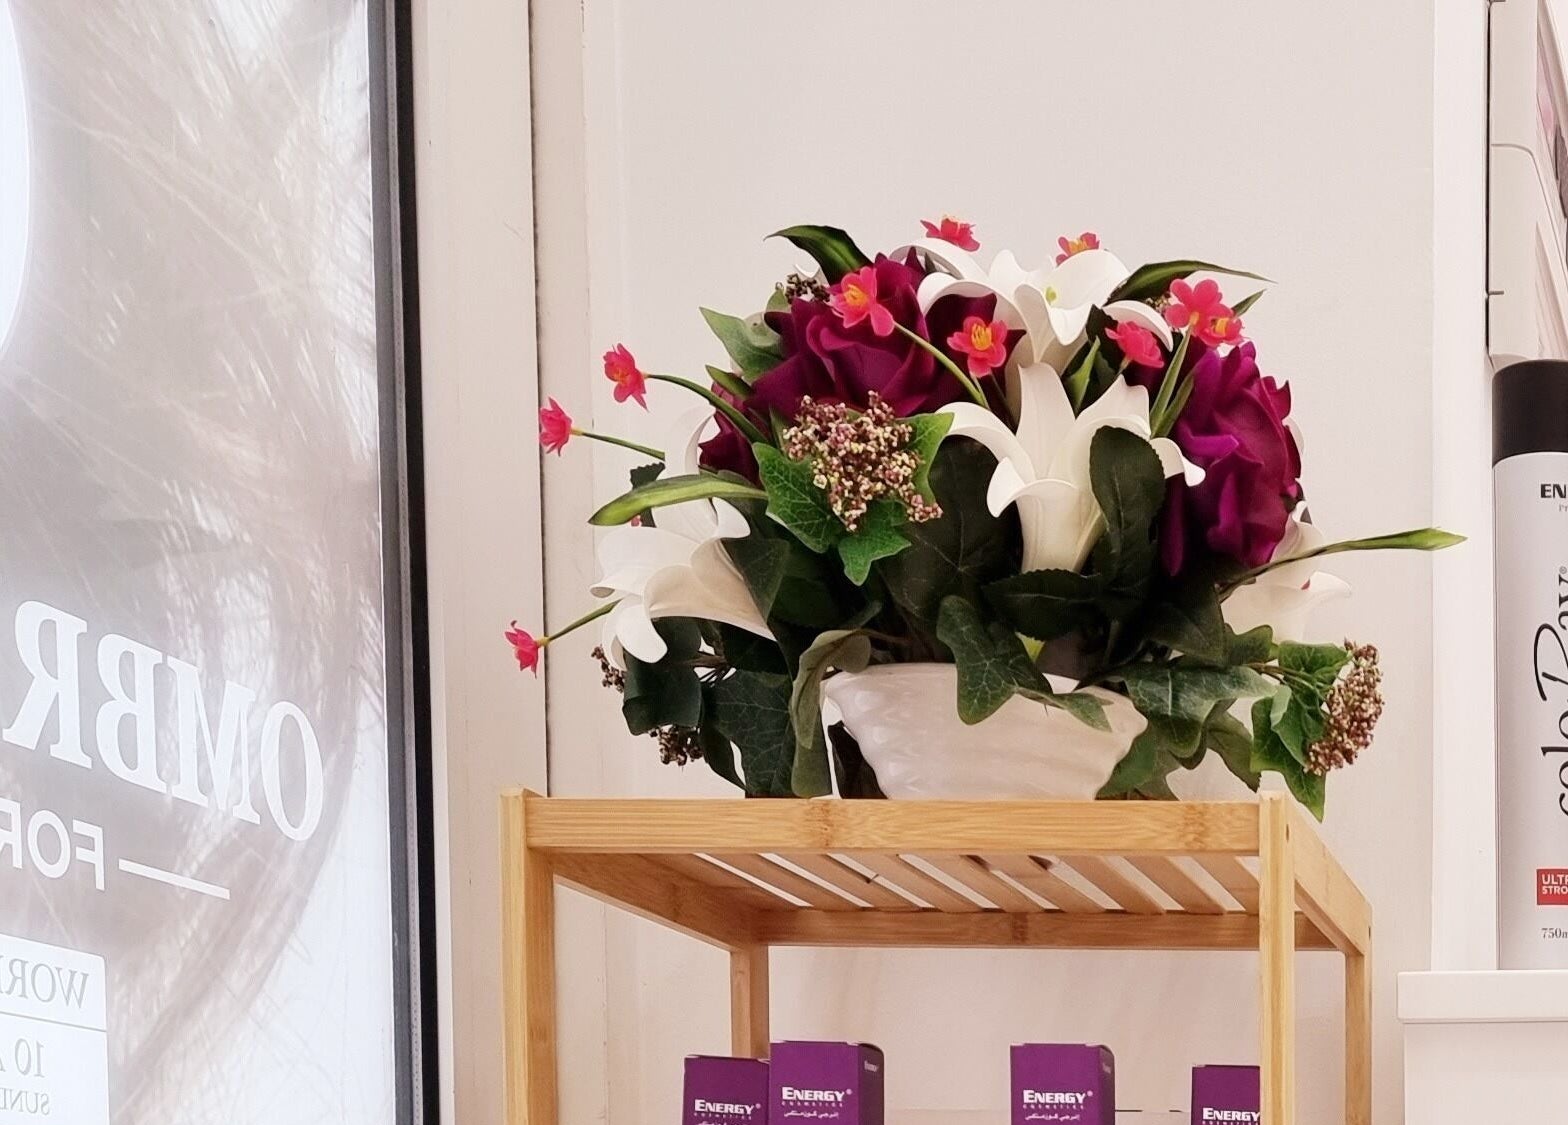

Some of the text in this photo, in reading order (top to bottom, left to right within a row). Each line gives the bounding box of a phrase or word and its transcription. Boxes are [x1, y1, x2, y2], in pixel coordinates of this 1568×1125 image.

[781, 1086, 845, 1102] ENERGY
[1022, 1089, 1086, 1104] ENERGY
[694, 1098, 755, 1115] ENERGY
[1202, 1107, 1261, 1122] ENERGY
